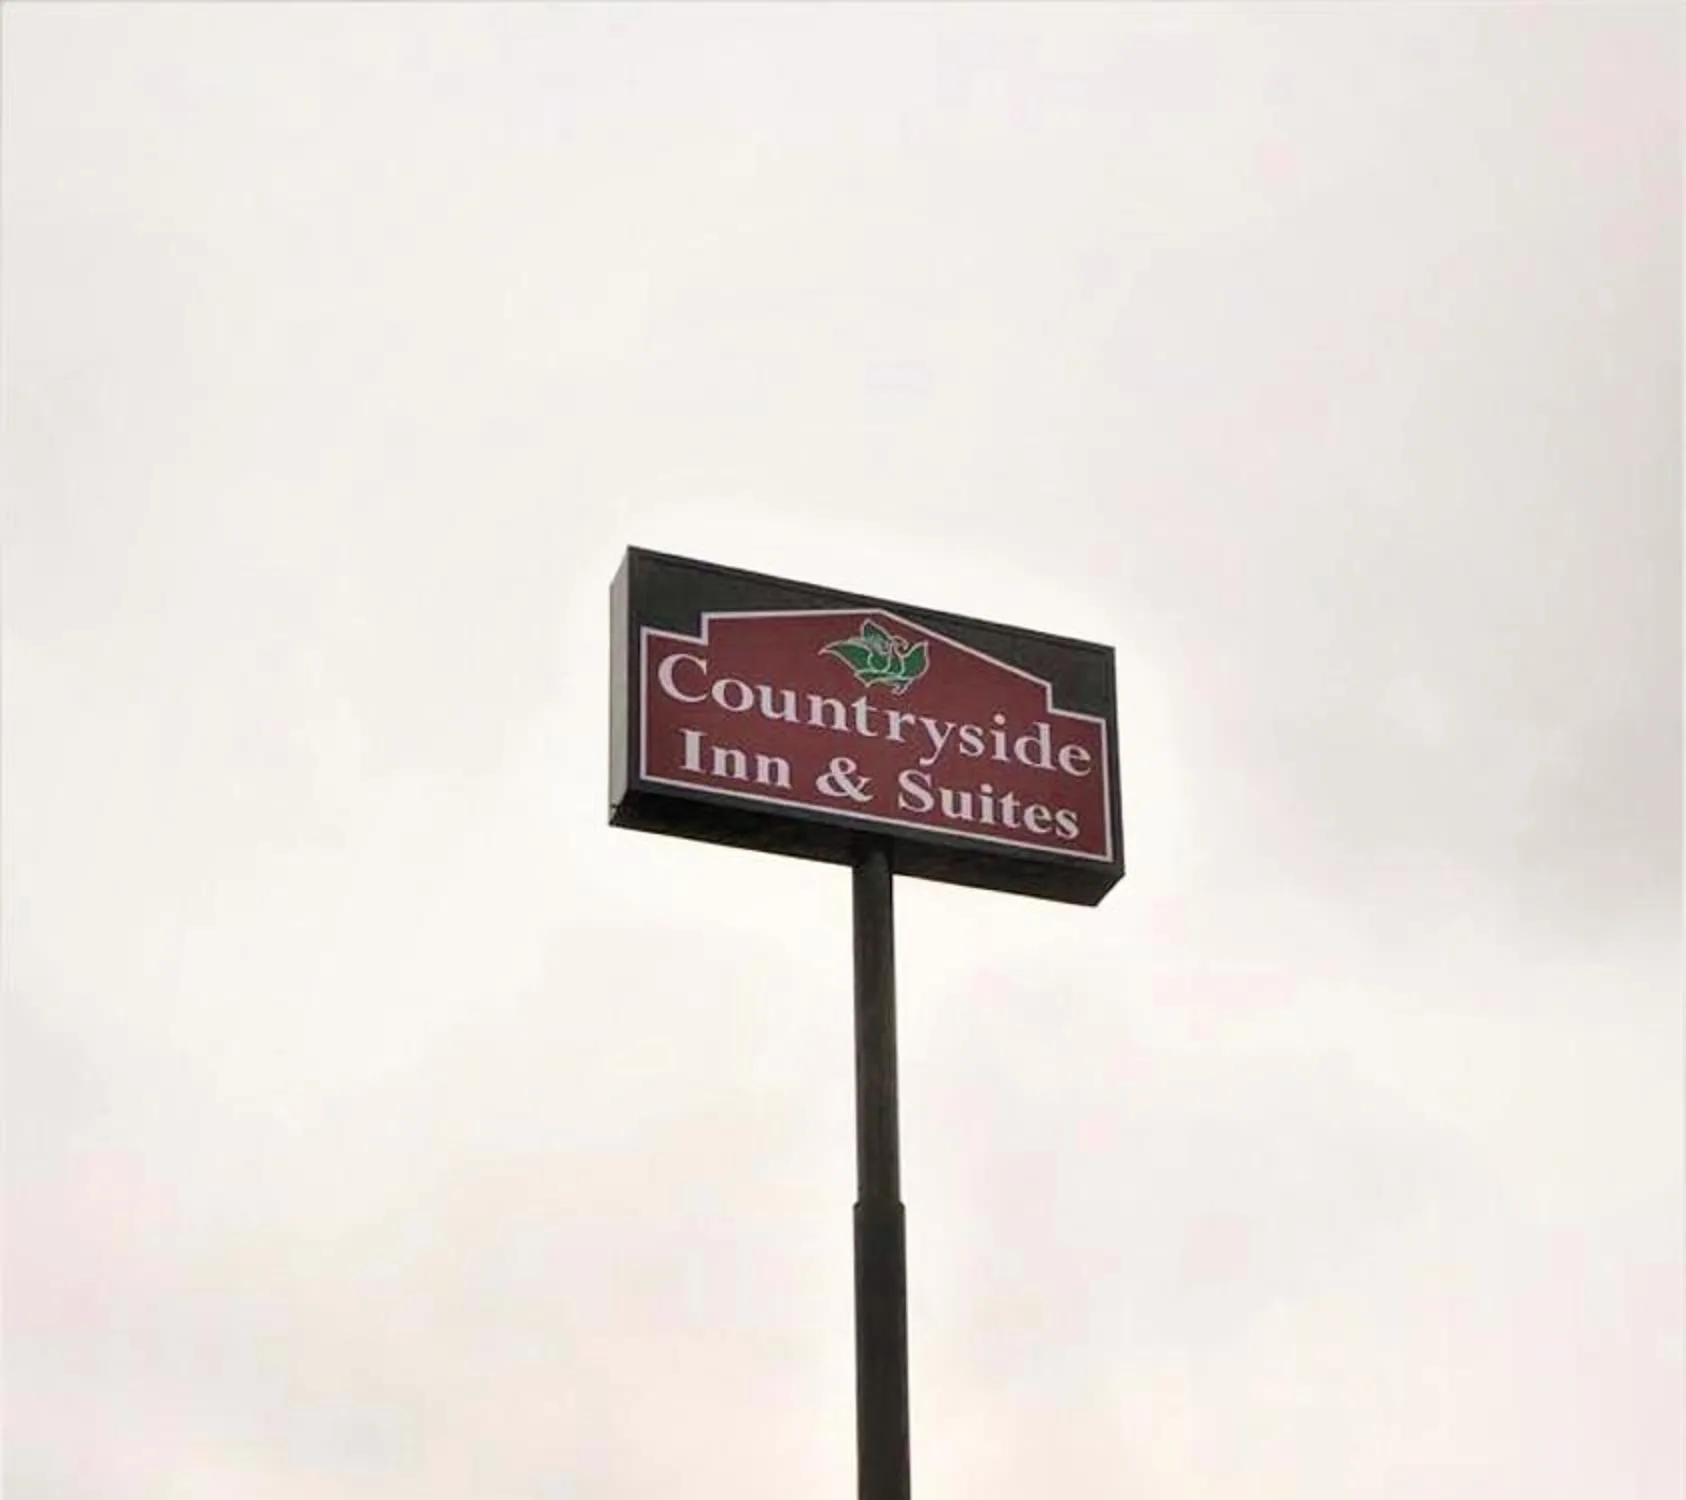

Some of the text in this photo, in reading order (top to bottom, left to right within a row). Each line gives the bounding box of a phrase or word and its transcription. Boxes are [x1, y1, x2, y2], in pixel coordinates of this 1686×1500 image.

[657, 652, 1091, 777] Countryside
[681, 728, 1079, 841] Inn & Suites
